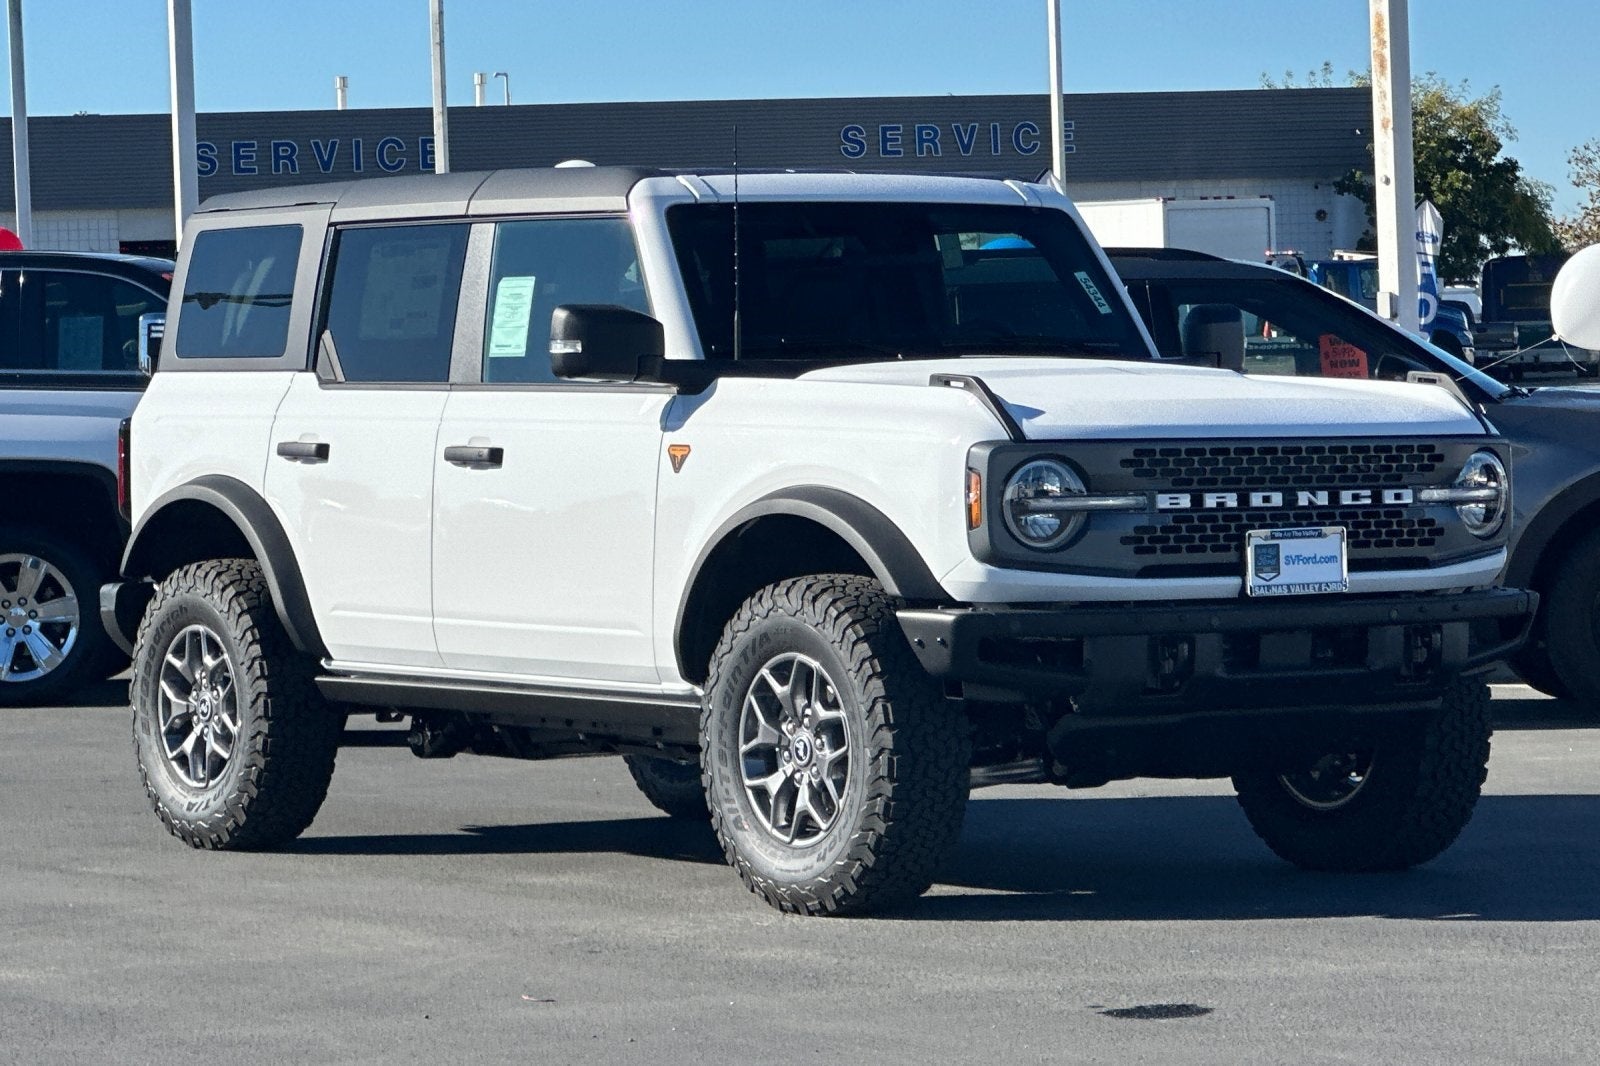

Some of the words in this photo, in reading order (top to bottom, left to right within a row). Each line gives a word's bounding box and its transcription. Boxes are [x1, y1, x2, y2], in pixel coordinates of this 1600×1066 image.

[197, 137, 436, 177] SERVICE
[1156, 488, 1414, 509] BRONCO
[1284, 553, 1339, 566] SVFord.com
[1290, 583, 1319, 593] VALLEY
